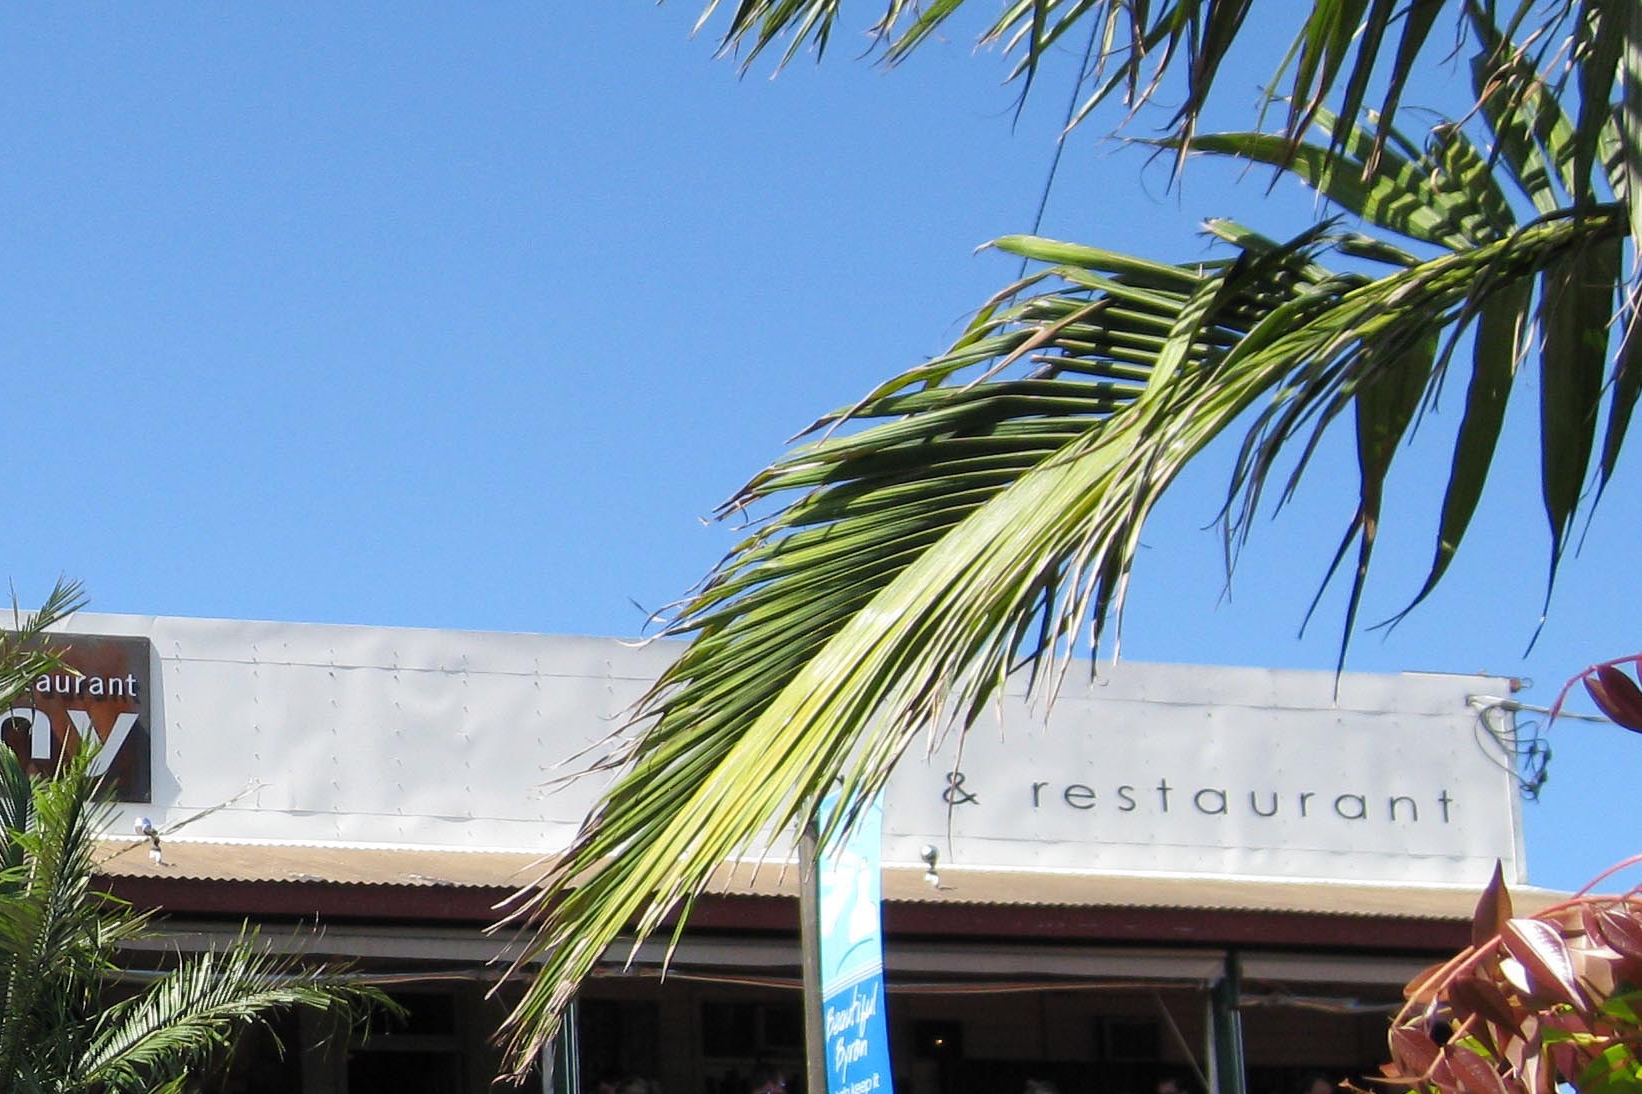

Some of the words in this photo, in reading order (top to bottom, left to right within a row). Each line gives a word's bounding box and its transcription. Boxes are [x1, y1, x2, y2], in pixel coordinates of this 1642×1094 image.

[942, 771, 980, 807] &
[1032, 776, 1454, 825] restaurant
[826, 981, 879, 1042] Beautiful
[835, 1036, 869, 1083] Byron
[872, 1072, 880, 1089] it
